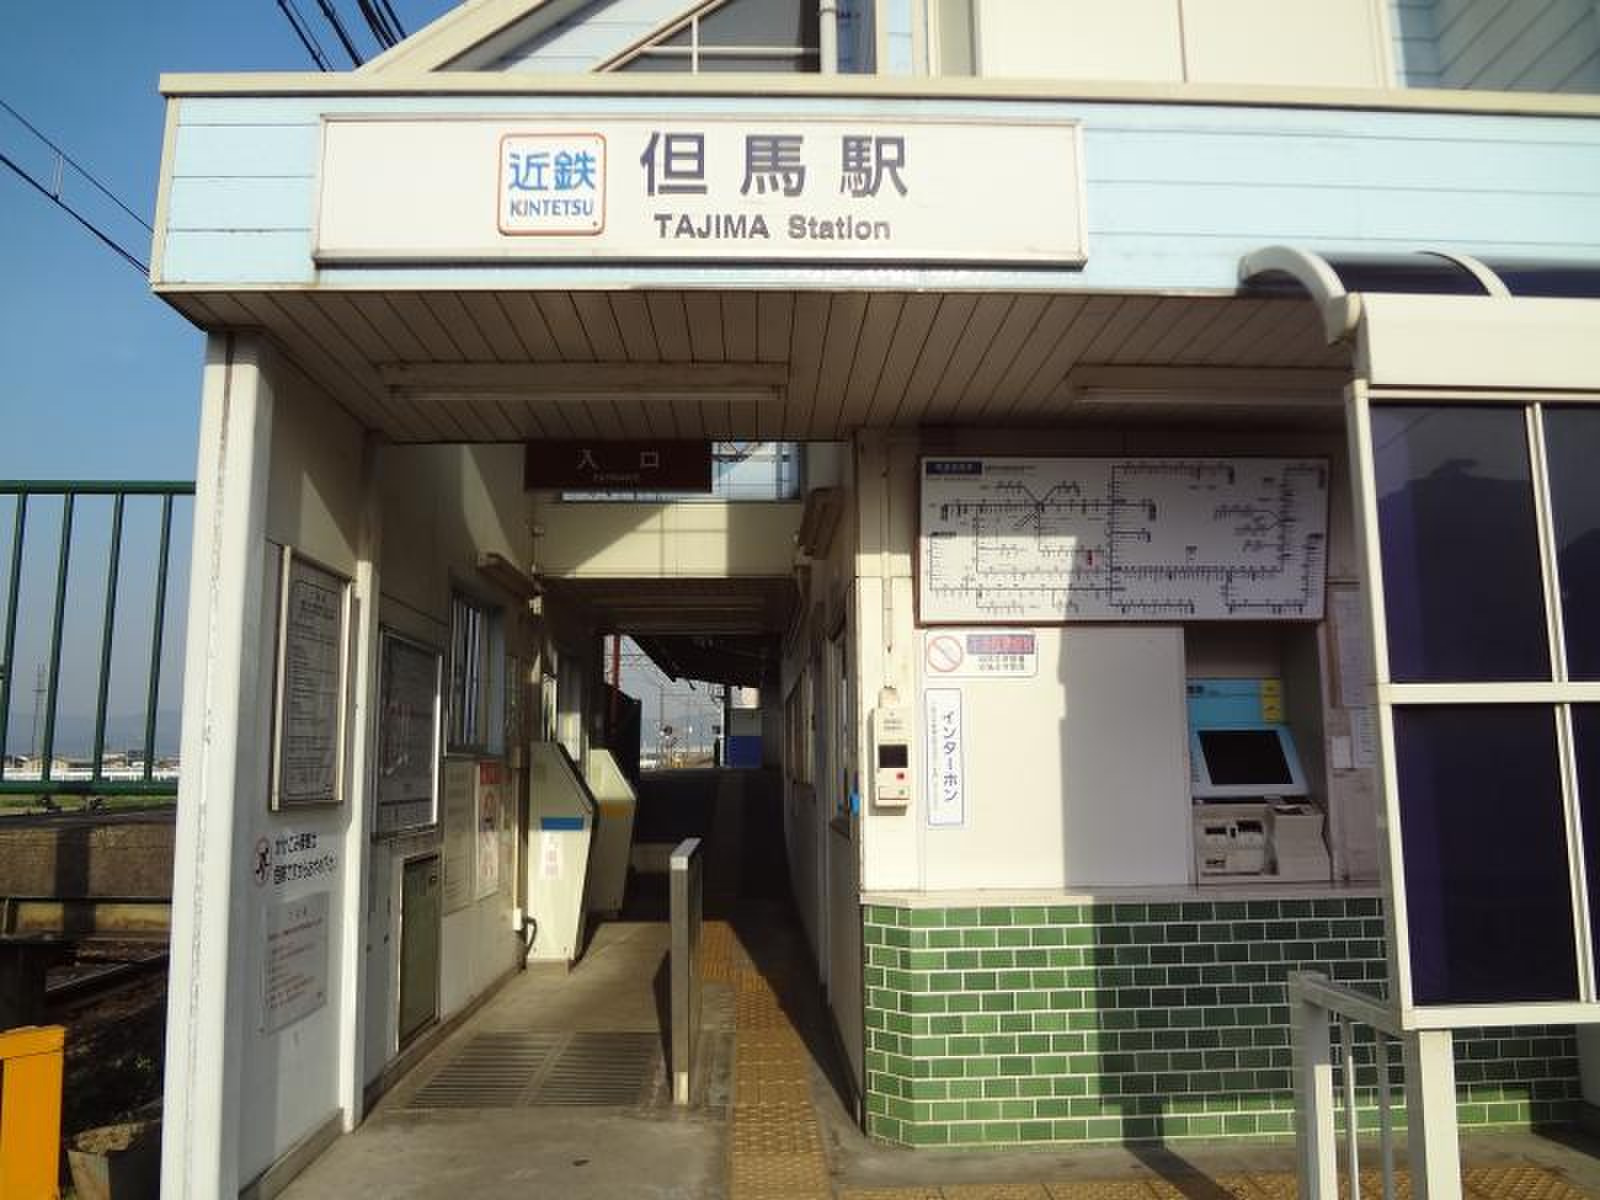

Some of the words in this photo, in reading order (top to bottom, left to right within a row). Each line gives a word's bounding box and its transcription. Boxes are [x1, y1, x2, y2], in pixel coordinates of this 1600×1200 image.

[509, 150, 596, 190] 近鉄
[640, 131, 907, 198] 但馬駅
[510, 198, 594, 217] KINTETSU
[654, 213, 770, 239] TAJIMA
[788, 213, 891, 240] Station
[576, 448, 660, 470] 入口
[942, 709, 959, 803] インターホン
